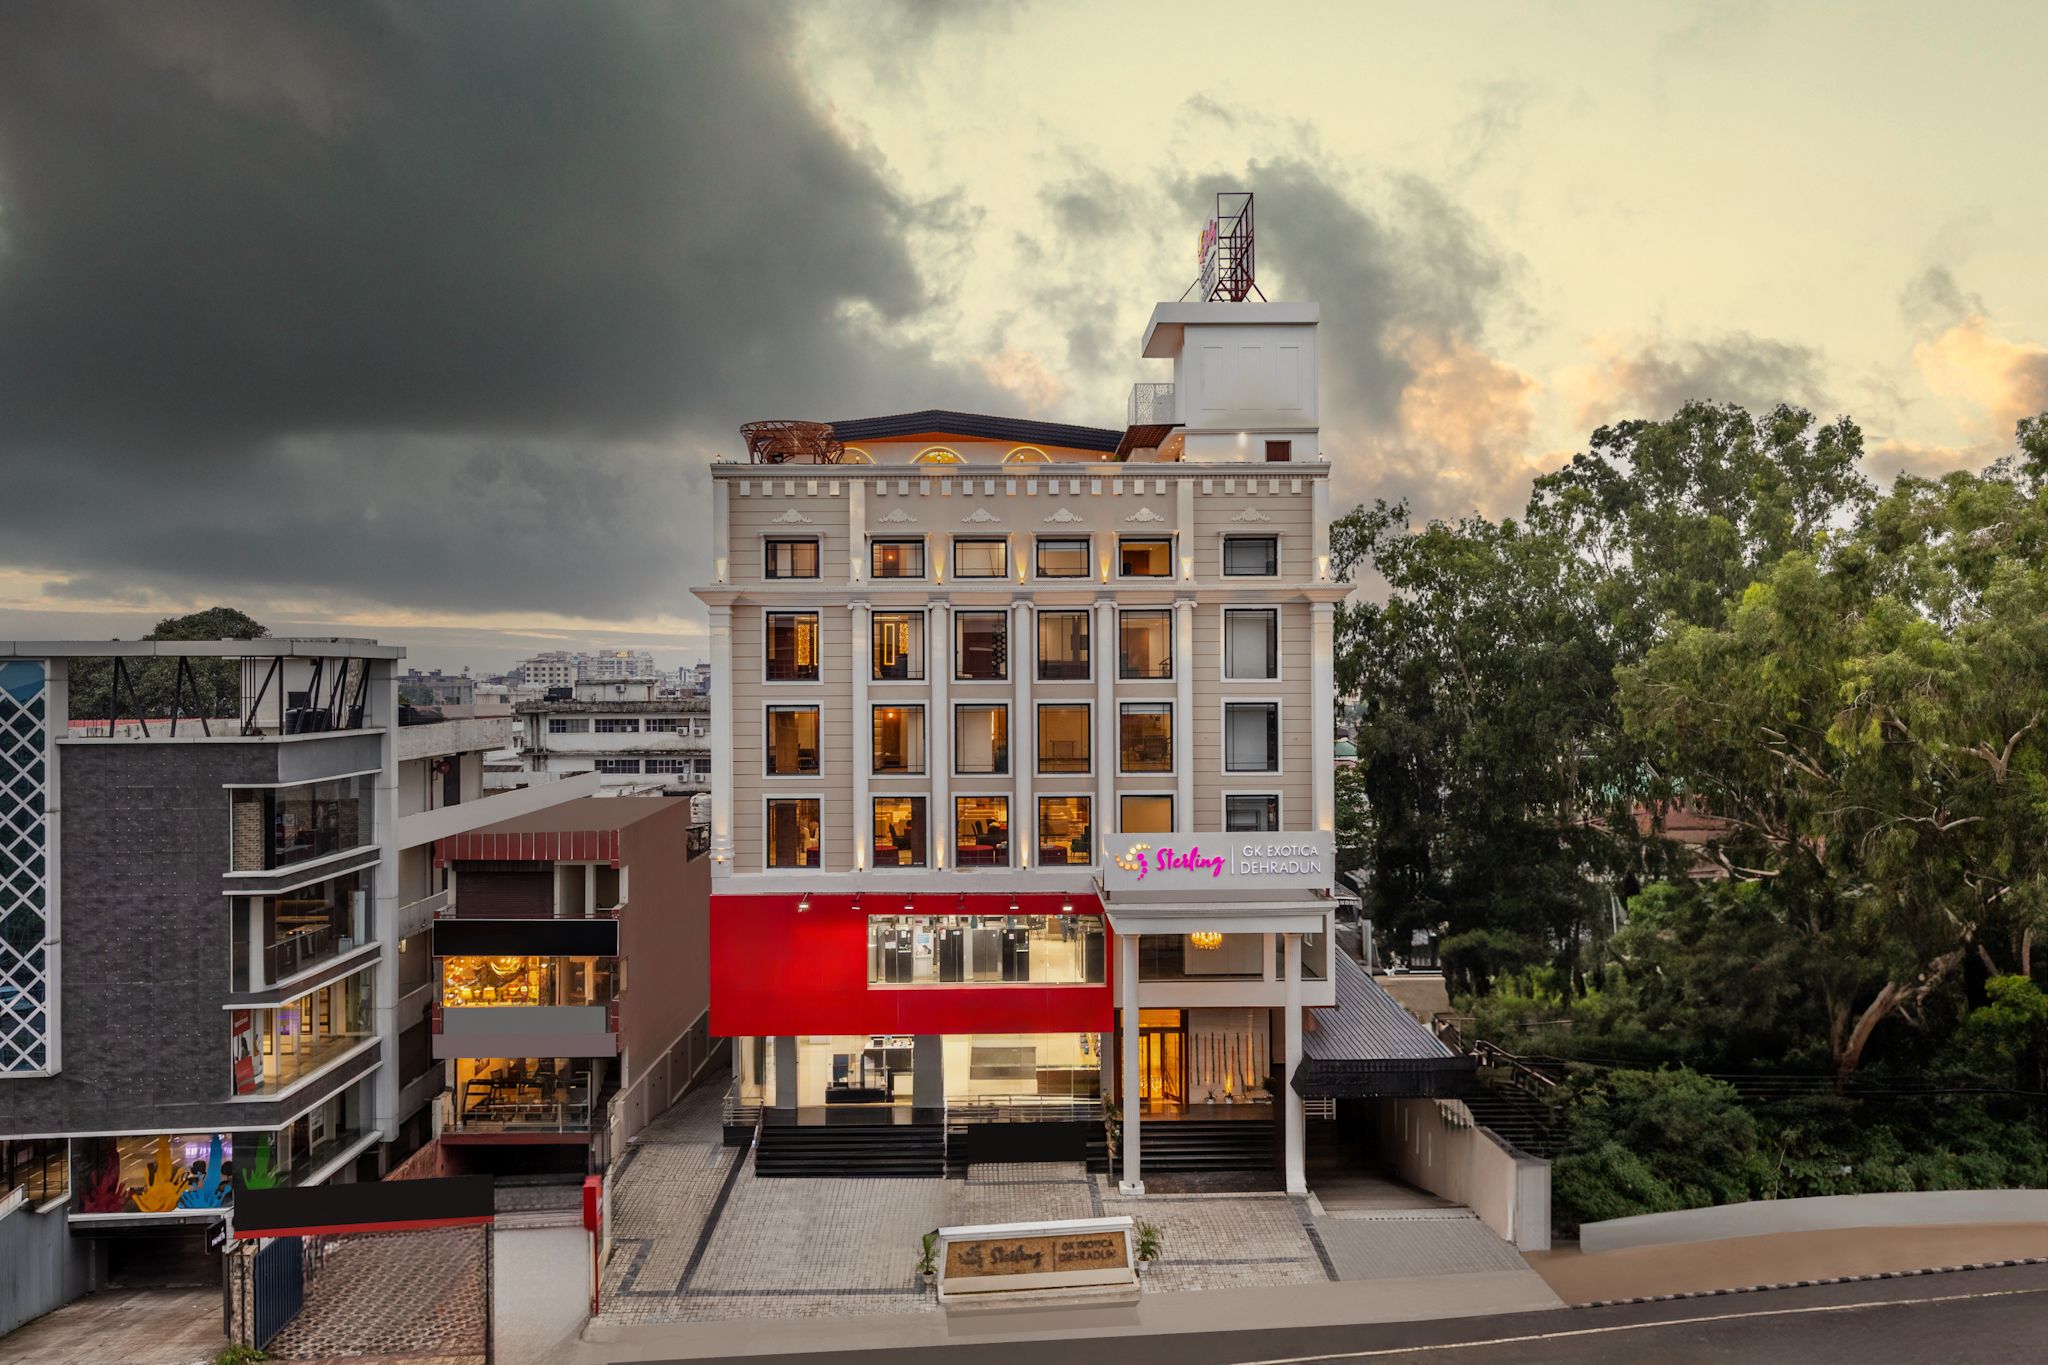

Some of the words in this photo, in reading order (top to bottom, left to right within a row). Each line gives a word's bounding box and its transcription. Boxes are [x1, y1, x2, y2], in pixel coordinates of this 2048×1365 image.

[1242, 845, 1262, 857] GK
[1267, 844, 1318, 857] EXOTICA
[1156, 846, 1225, 878] Sterling
[1240, 861, 1321, 875] DEHRADUN
